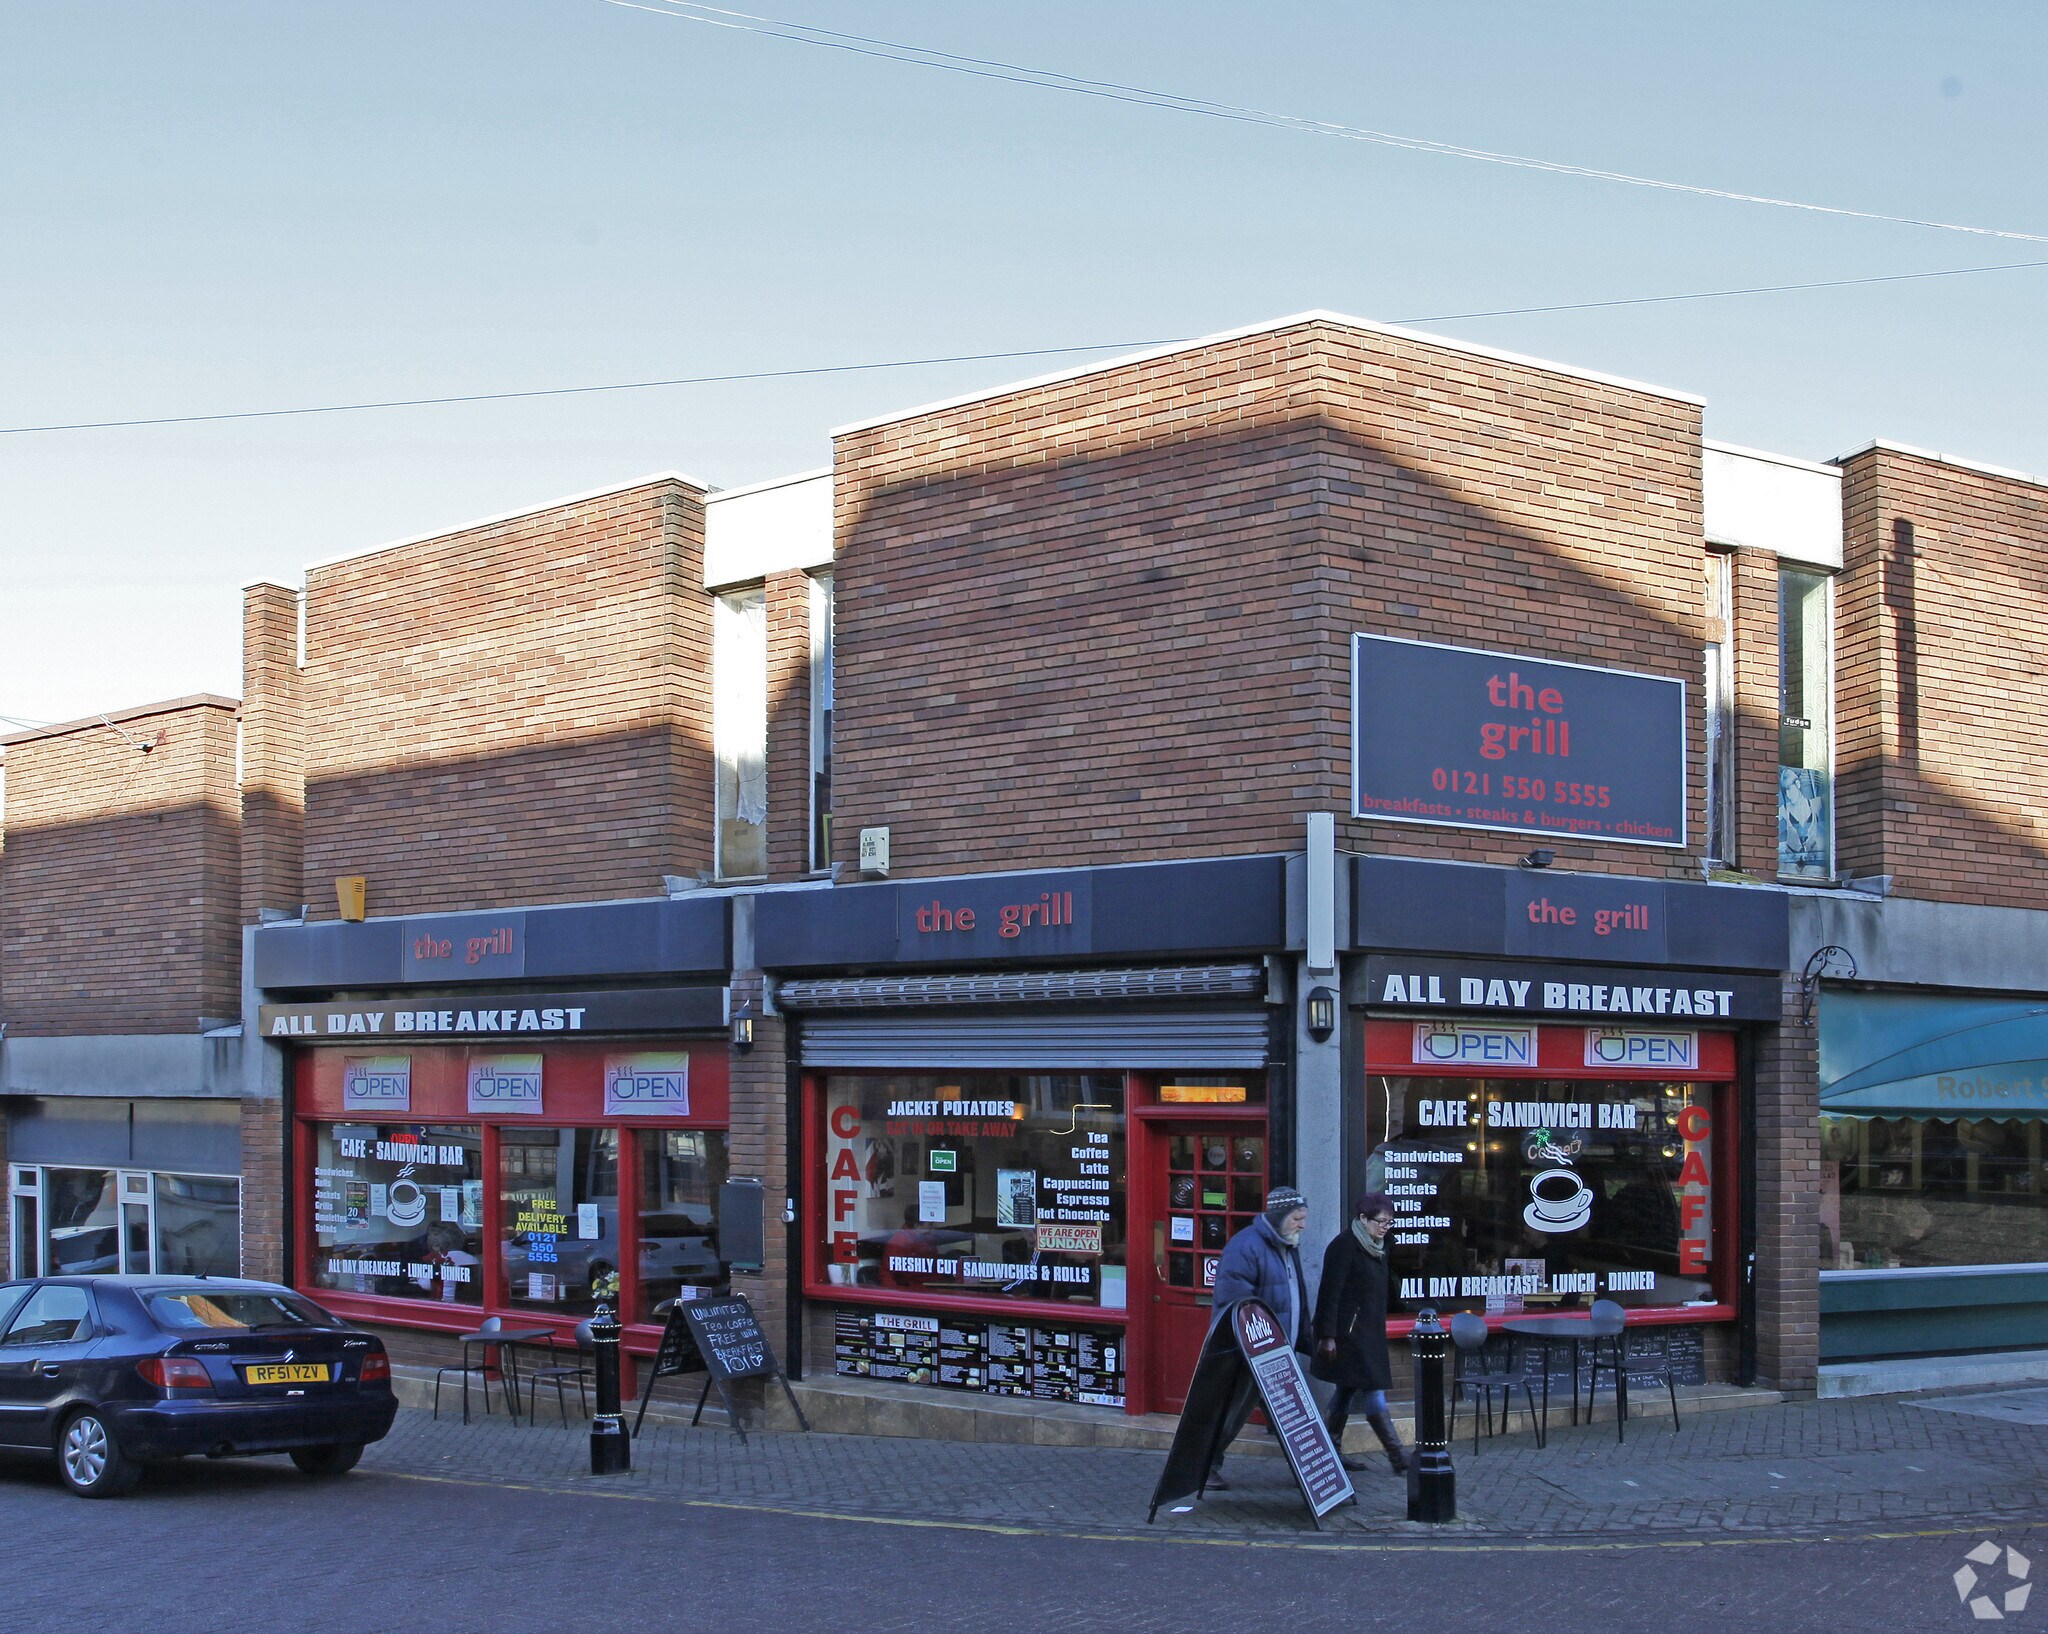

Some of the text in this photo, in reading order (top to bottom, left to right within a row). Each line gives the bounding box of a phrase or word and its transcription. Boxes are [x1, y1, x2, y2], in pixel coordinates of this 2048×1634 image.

[1486, 672, 1564, 714] the
[1786, 717, 1809, 727] fudge
[1479, 717, 1570, 760] grill
[1432, 768, 1611, 808] 0121 550 5555
[1363, 793, 1452, 816] breakfasts
[1467, 805, 1518, 823] steaks
[1523, 810, 1536, 825] &
[1540, 811, 1601, 833] burgers
[1615, 821, 1674, 838] chicken
[915, 891, 1073, 938] the grill
[1527, 898, 1648, 935] the grill
[413, 928, 513, 964] the grill
[1382, 974, 1733, 1017] ALL DAY BREAKFAST
[271, 1007, 586, 1035] ALL DAY BREAKFAST
[1936, 1076, 2033, 1100] Robert
[887, 1100, 1015, 1116] JACKET POTATOES
[1418, 1100, 1468, 1127] CAFE
[1488, 1101, 1592, 1129] SANDWICH
[1598, 1103, 1637, 1130] BAR
[928, 1121, 944, 1136] OR
[947, 1121, 978, 1137] TAKE
[982, 1122, 1017, 1137] AWAY
[1087, 1132, 1108, 1144] Tea
[340, 1138, 366, 1158] CAFE
[376, 1141, 436, 1165] SANDWICH
[439, 1146, 464, 1166] BAR
[1071, 1147, 1109, 1159] Coffee
[1384, 1150, 1463, 1163] Sandwiches
[315, 1166, 353, 1178] Sandwiches
[1080, 1162, 1109, 1175] Latte
[1384, 1166, 1418, 1179] Rolls
[315, 1178, 332, 1188] Rolls
[831, 1105, 861, 1264] CAFE
[1043, 1177, 1109, 1193] Cappuccino
[1384, 1183, 1437, 1195] Jackets
[1678, 1105, 1711, 1275] CAFE
[315, 1190, 341, 1200] Jackets
[1056, 1193, 1110, 1208] Espresso
[315, 1201, 333, 1211] Grills
[532, 1200, 557, 1210] FREE
[1392, 1200, 1422, 1212] rills
[315, 1213, 348, 1223] Omelettes
[518, 1212, 566, 1224] DELIVERY
[1037, 1208, 1110, 1222] Hot Chocolate
[1393, 1215, 1451, 1228] melettes
[315, 1223, 337, 1233] Salads
[515, 1222, 568, 1234] AVAILABLE
[1040, 1227, 1098, 1238] WE ARE OPEN
[528, 1232, 557, 1243] 0121
[1039, 1237, 1099, 1251] SUNDAYS
[531, 1242, 554, 1252] 550
[528, 1252, 558, 1263] 5555
[328, 1258, 341, 1273] ALL
[342, 1259, 357, 1274] DAY
[358, 1260, 401, 1276] BREAKFAST
[408, 1262, 433, 1280] LUNCH
[441, 1264, 471, 1283] DINNER
[889, 1256, 1090, 1283] FRESHLY CUT SANDWICHES & ROLLS
[1400, 1277, 1427, 1299] ALL
[1429, 1276, 1458, 1298] DAY
[1461, 1274, 1540, 1297] BREAKFAST
[1552, 1272, 1596, 1294] LUNCH
[1608, 1271, 1655, 1292] DINNER
[690, 1303, 746, 1320] UNLIMITED
[881, 1316, 932, 1330] THE GRILL
[706, 1333, 737, 1347] FREE
[712, 1341, 764, 1360] BREAKFAST
[256, 1365, 319, 1381] RF51 YZV
